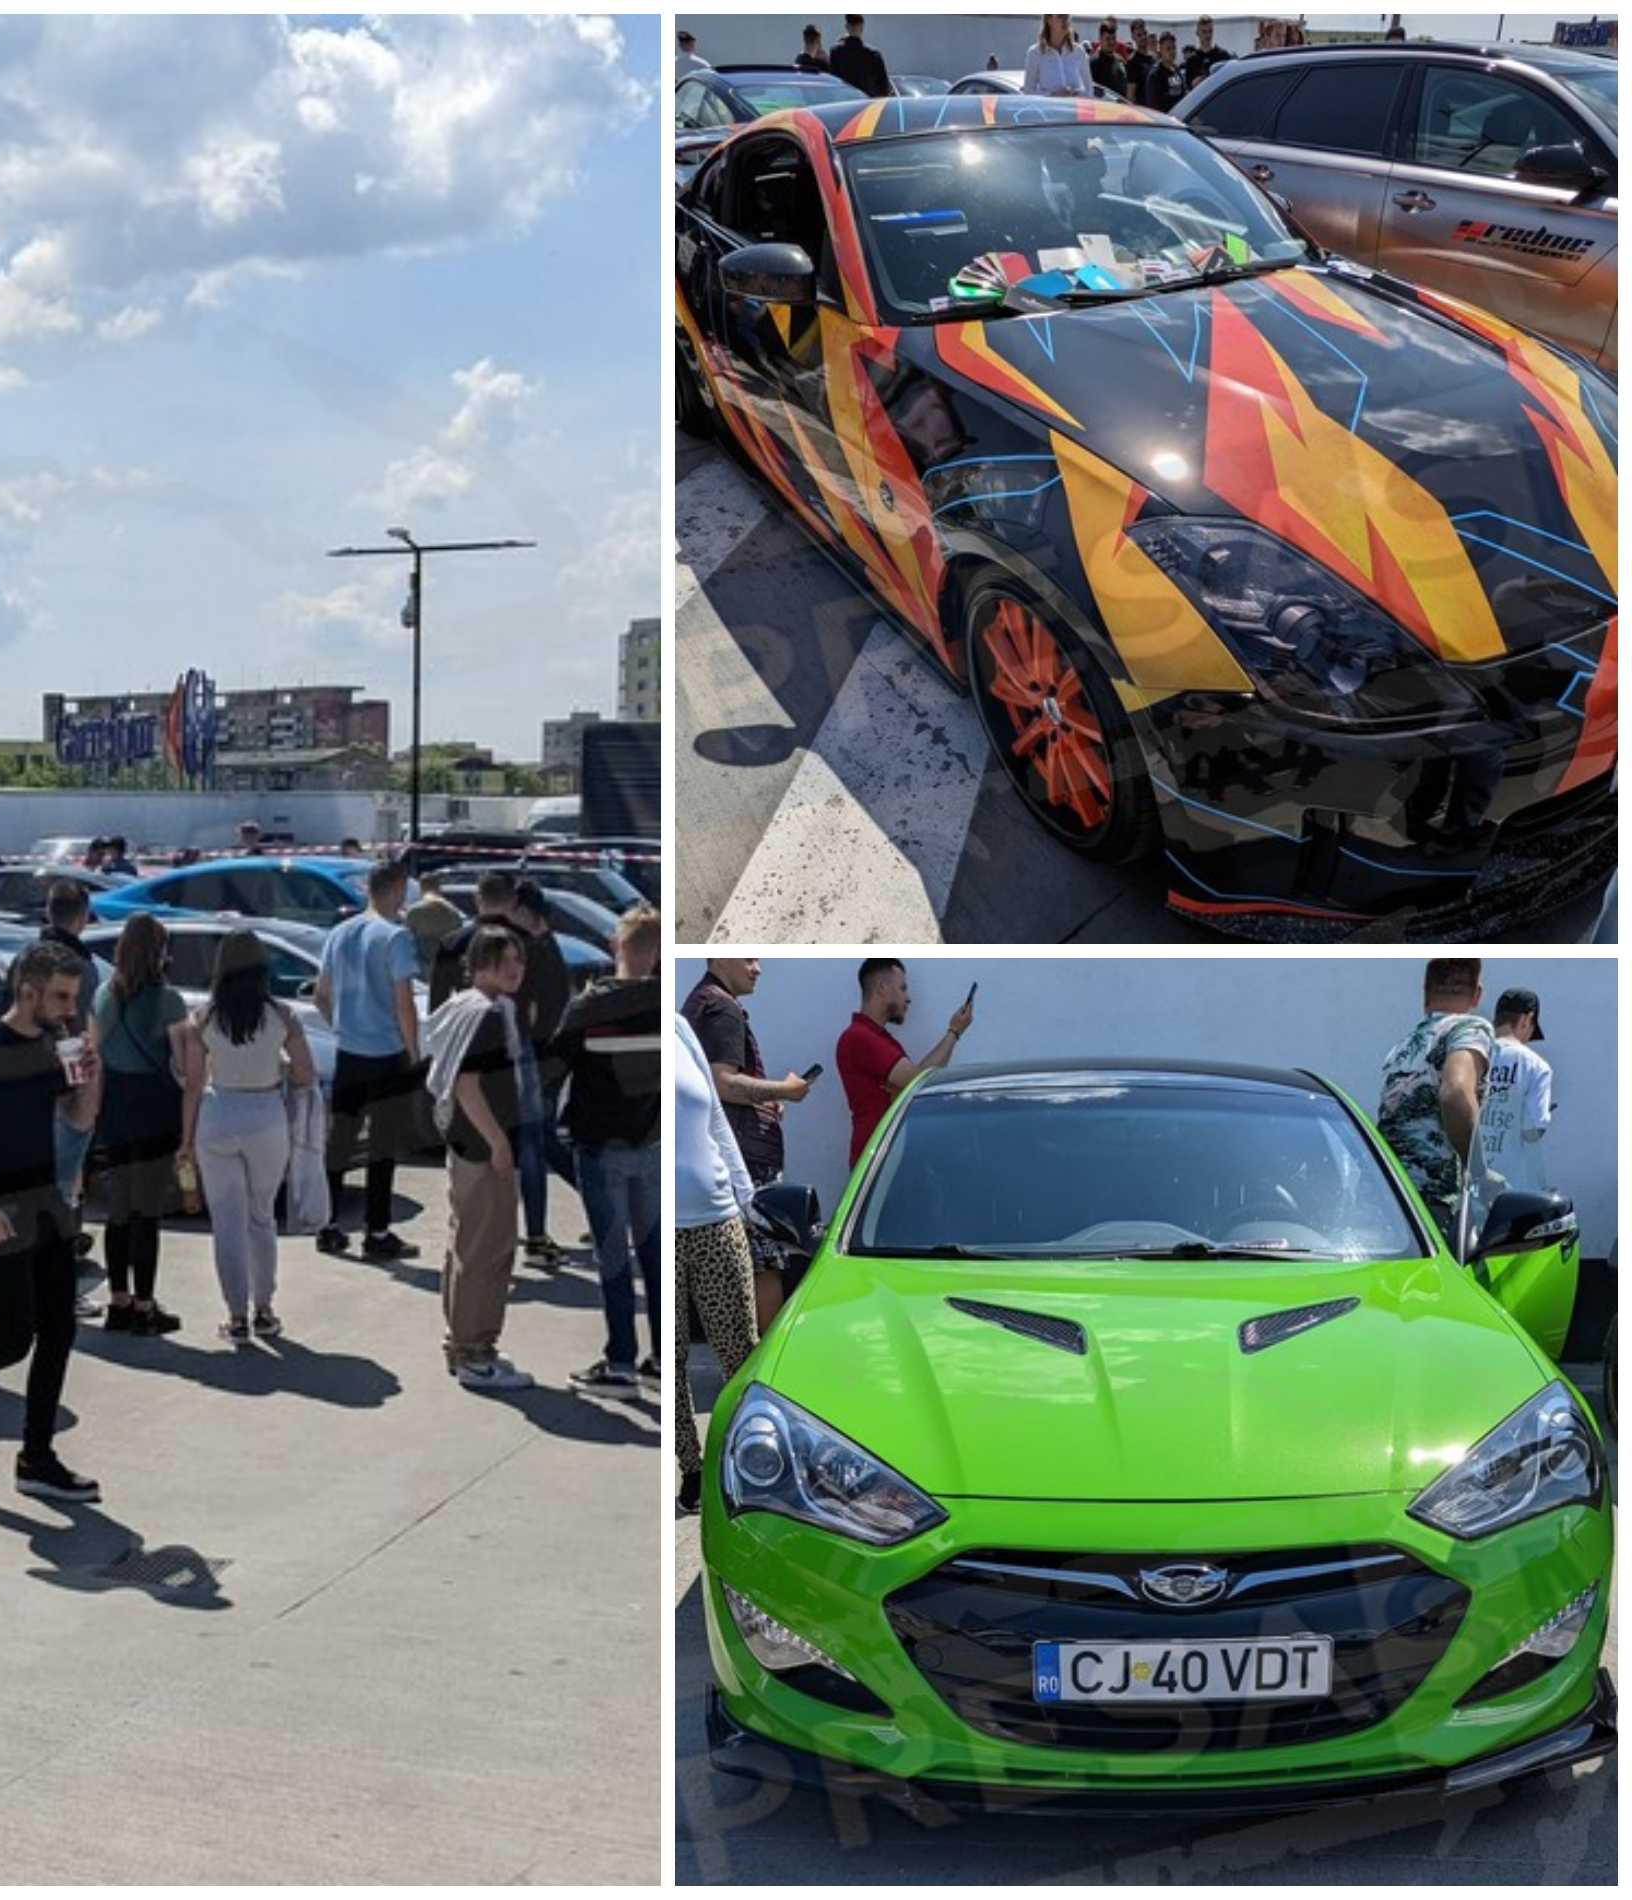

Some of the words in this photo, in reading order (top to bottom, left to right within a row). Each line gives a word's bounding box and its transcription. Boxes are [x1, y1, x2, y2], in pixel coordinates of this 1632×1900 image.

[1038, 1675, 1059, 1695] RO
[1070, 1650, 1131, 1695] CJ
[1151, 1649, 1209, 1694] 40
[1220, 1645, 1319, 1692] VDT
